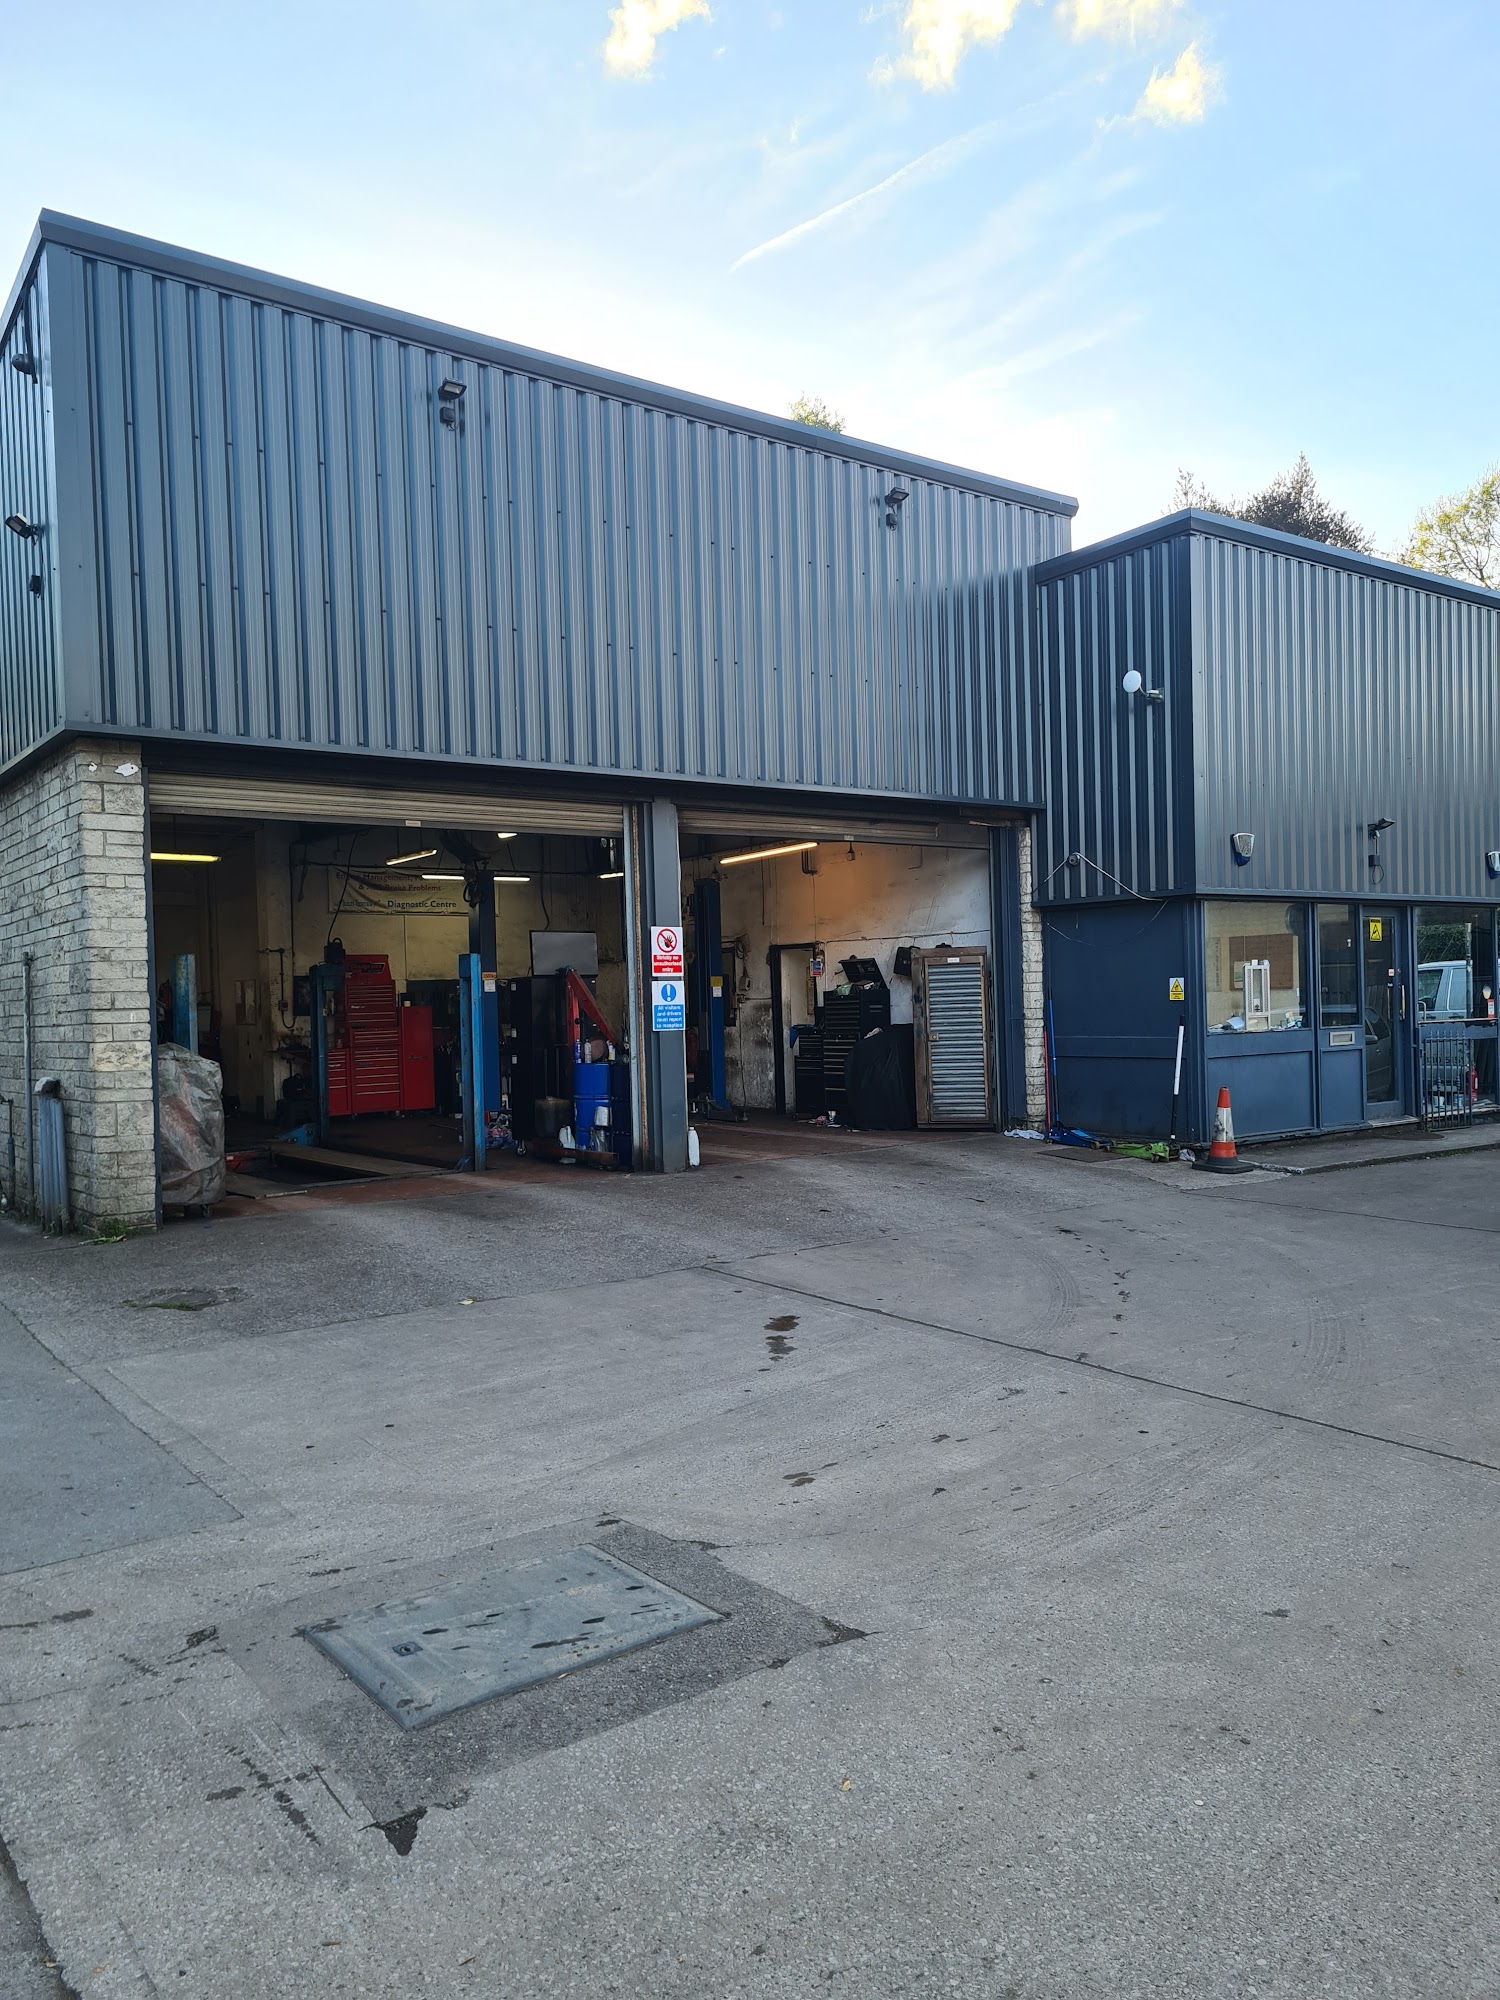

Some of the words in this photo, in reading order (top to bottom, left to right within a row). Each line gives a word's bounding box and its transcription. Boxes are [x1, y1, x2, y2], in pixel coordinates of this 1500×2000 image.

[364, 874, 413, 882] Management,
[408, 884, 442, 892] Problems
[387, 900, 430, 909] Diagnostic
